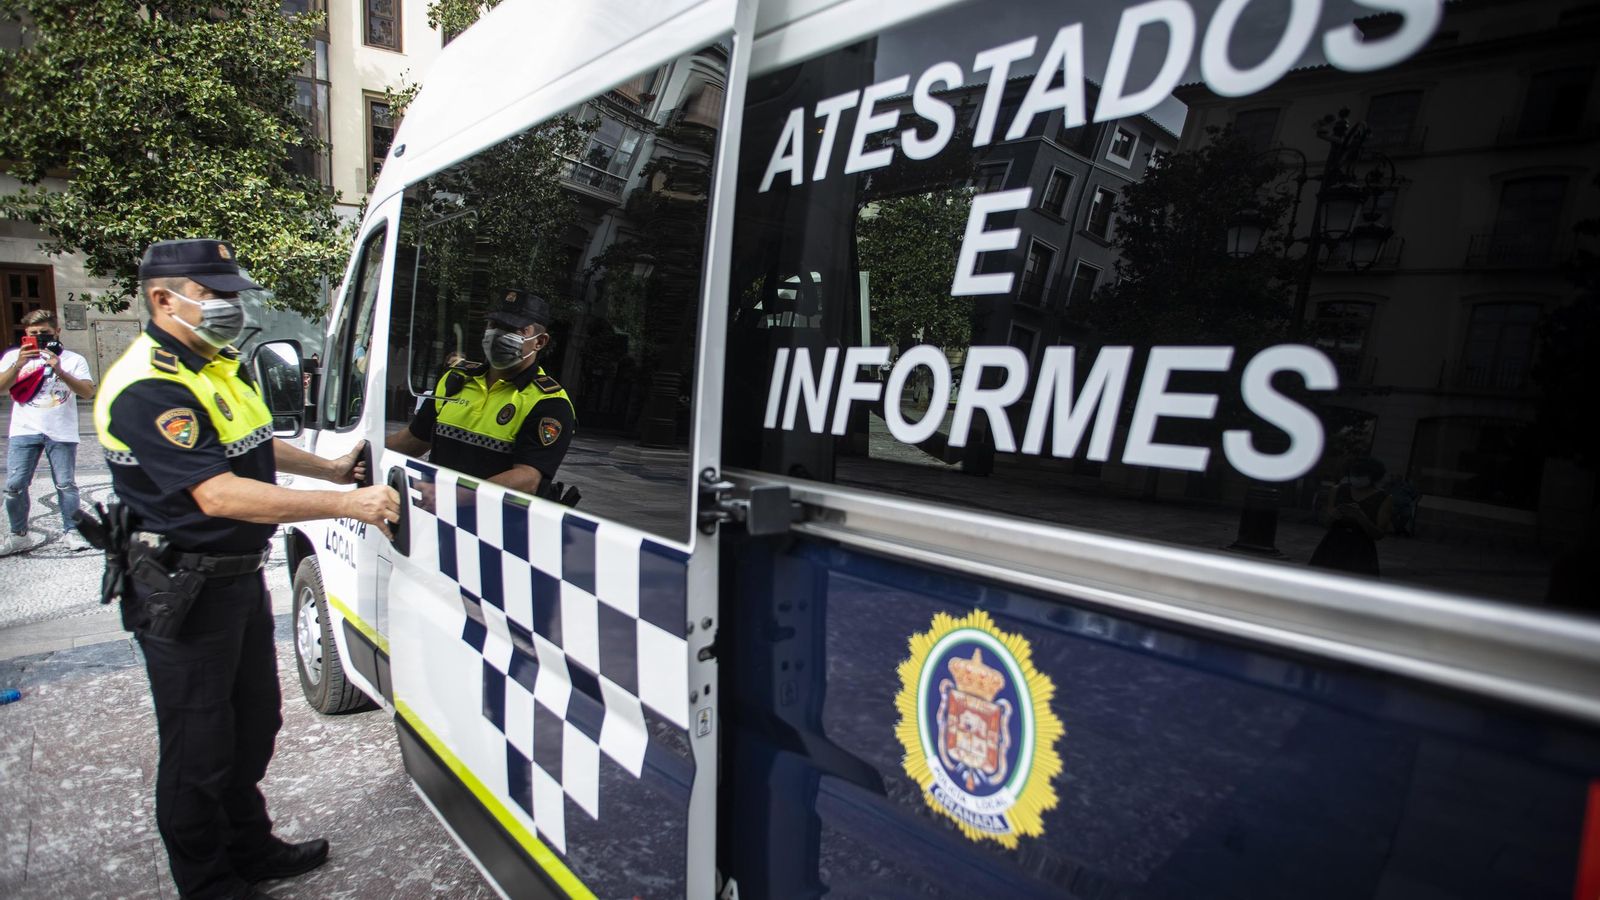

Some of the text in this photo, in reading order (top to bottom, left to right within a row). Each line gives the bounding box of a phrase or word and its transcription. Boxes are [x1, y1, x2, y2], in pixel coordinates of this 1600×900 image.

[758, 0, 1441, 192] ATESTADOS
[950, 187, 1033, 296] E
[67, 292, 75, 301] 2
[763, 344, 1337, 481] INFORMES
[325, 526, 356, 569] LOCAL
[934, 787, 1007, 832] GRANADA
